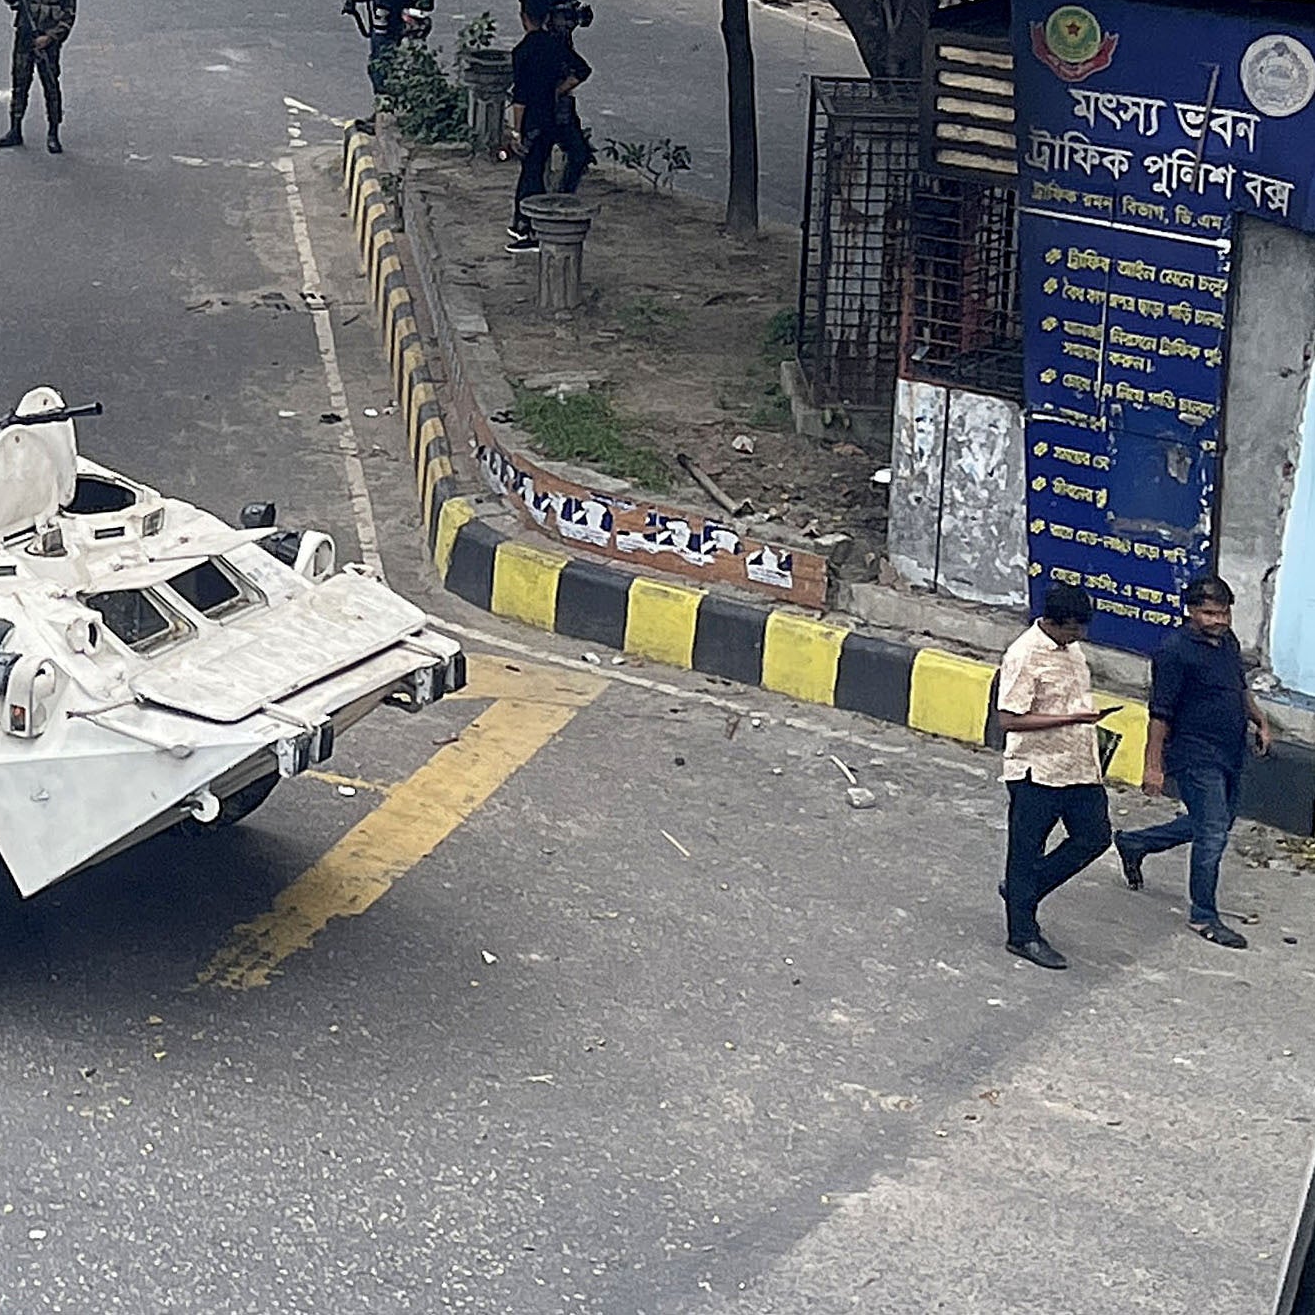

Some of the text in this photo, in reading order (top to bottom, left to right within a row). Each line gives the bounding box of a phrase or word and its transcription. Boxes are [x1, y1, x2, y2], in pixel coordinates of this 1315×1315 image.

[1069, 88, 1261, 153] মৎস্য ভবন
[1024, 124, 1133, 180] ট্রাফিক
[1243, 170, 1295, 218] বক্স
[1175, 204, 1224, 231] ডি.এম
[1198, 274, 1229, 299] চলু
